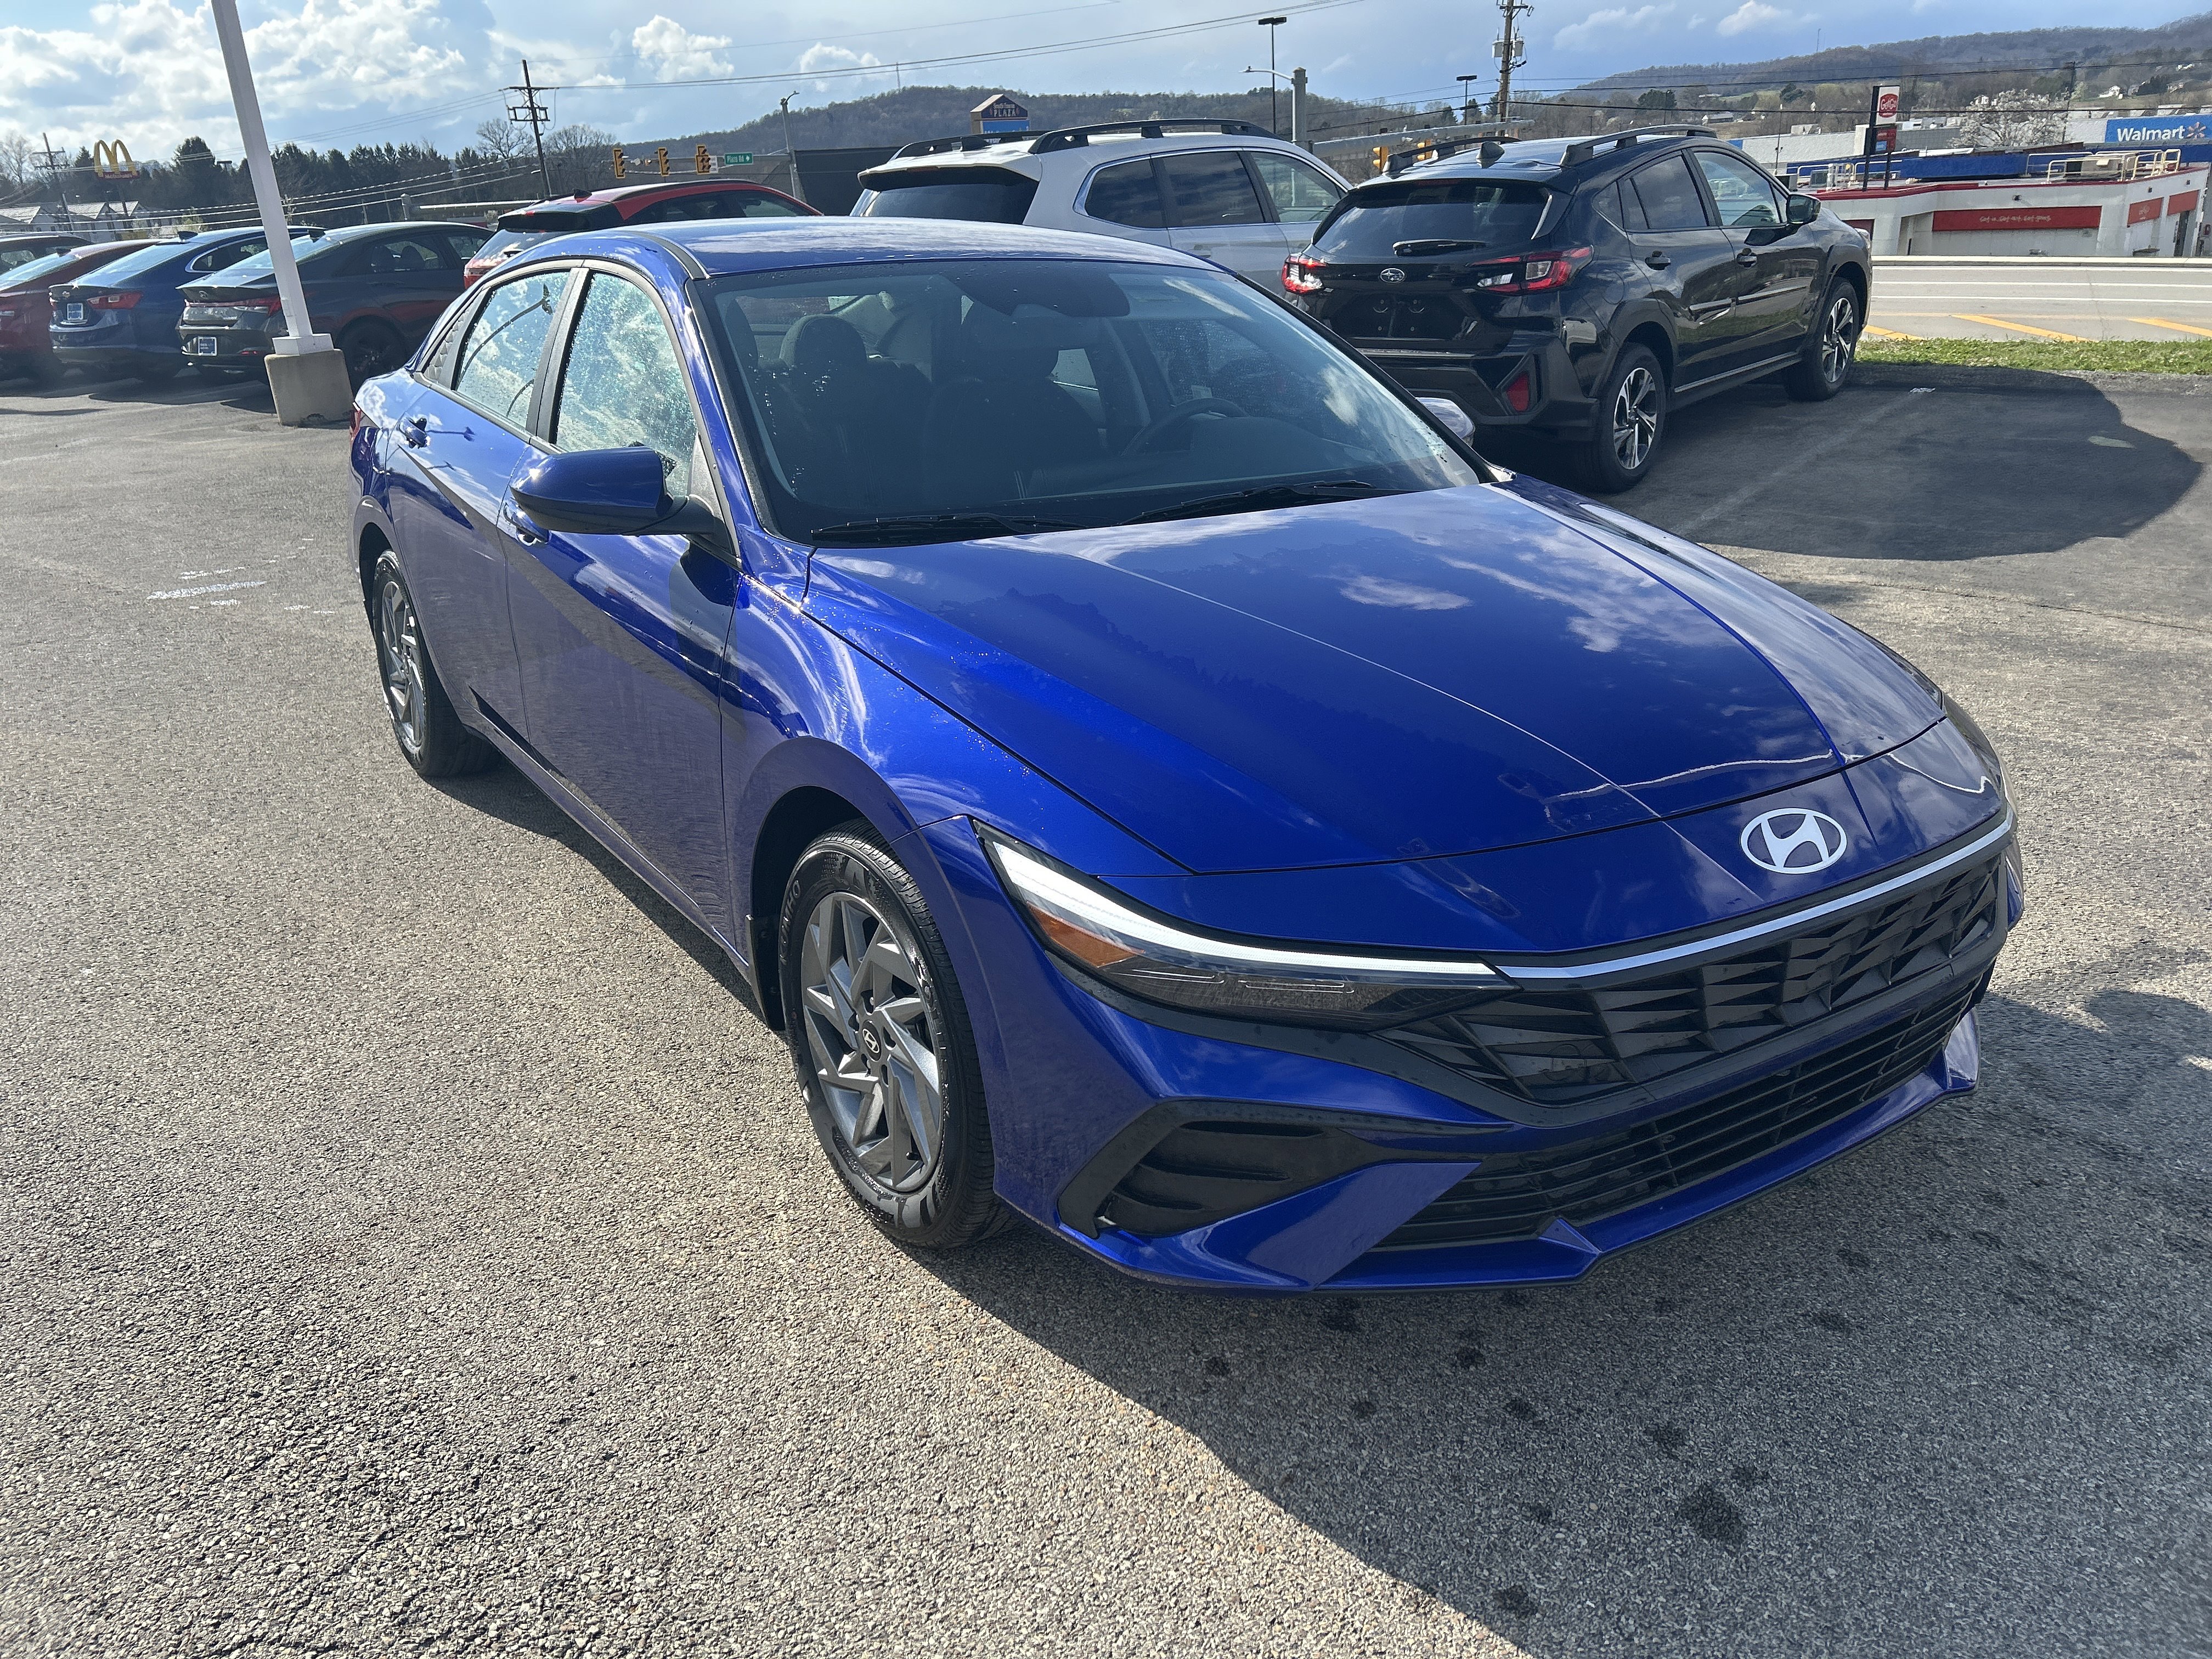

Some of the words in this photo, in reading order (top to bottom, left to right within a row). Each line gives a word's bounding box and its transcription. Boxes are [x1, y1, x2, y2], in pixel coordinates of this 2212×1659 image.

[994, 109, 1017, 117] PLAZA
[2117, 125, 2186, 142] Walmart
[779, 879, 801, 966] KUMHO
